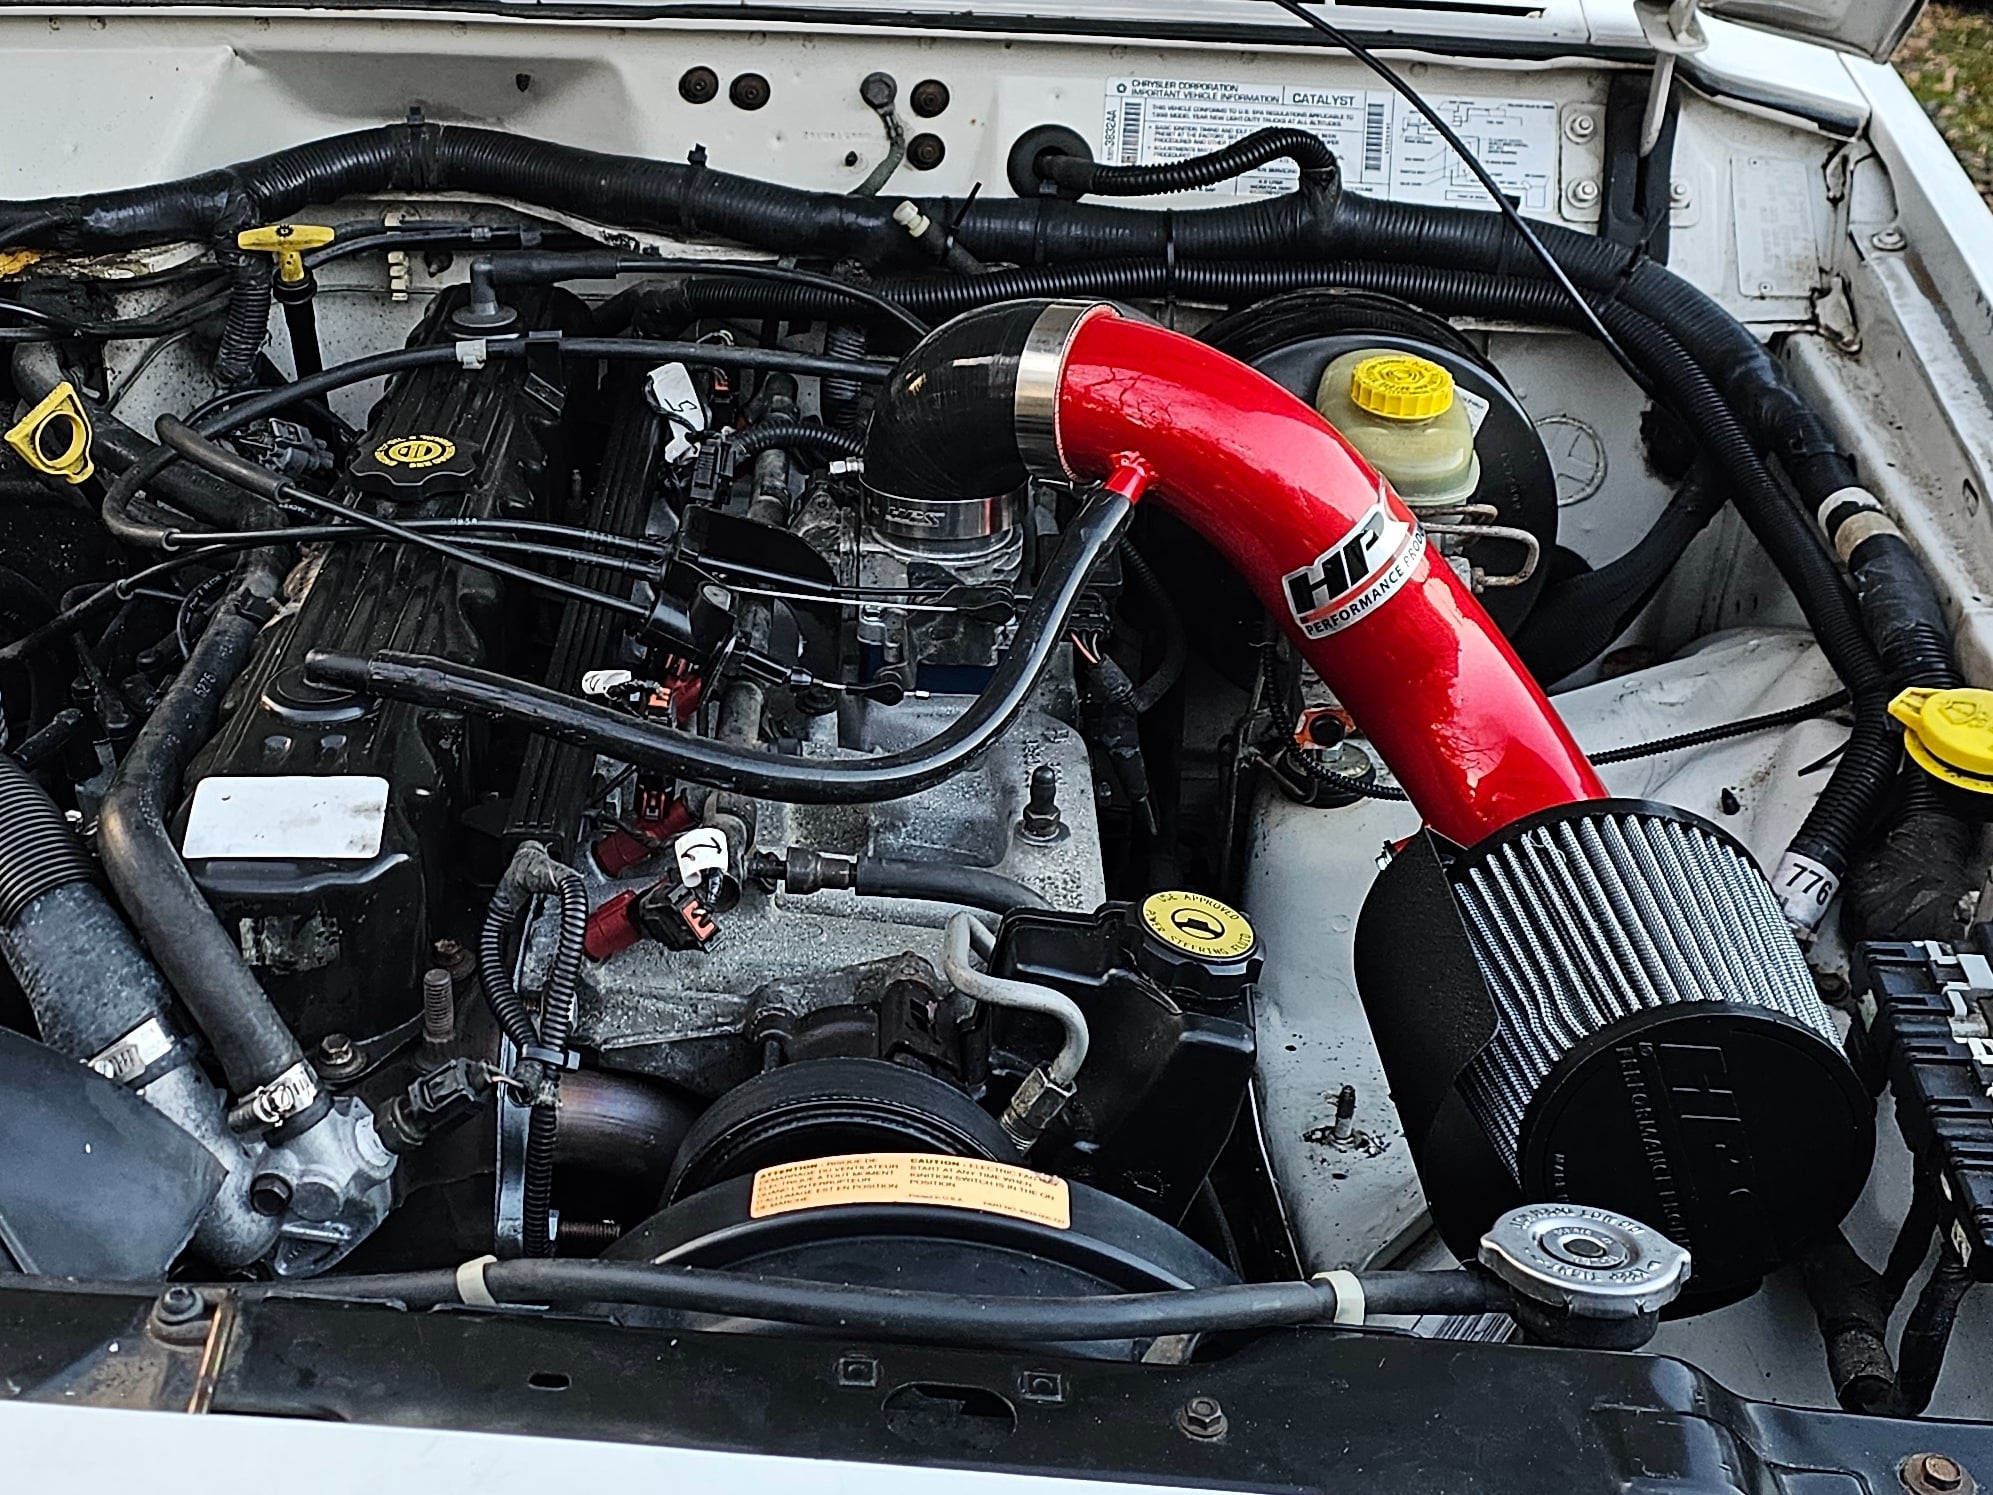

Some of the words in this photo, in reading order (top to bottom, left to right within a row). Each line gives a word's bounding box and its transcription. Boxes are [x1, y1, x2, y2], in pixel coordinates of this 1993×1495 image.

[1131, 79, 1177, 90] CHRYSLER
[1178, 81, 1239, 93] CORPORATION
[1131, 88, 1181, 98] IMPORTANT
[1183, 91, 1218, 100] VEHICLE
[1220, 92, 1280, 103] INFORMATION
[1292, 92, 1356, 107] CATALYST
[1104, 109, 1117, 147] 3832AA
[1304, 566, 1405, 636] PERFORMANCE
[1785, 862, 1833, 906] 776
[1183, 893, 1240, 921] APPROVED
[760, 1163, 818, 1179] ATTENTION
[835, 1163, 899, 1172] VENTILATEUR
[910, 1157, 960, 1167] CAUTION
[969, 1162, 1016, 1176] ELECTRIC
[909, 1172, 953, 1181] IGNITION
[955, 1175, 993, 1187] SWITCH
[909, 1179, 956, 1188] POSITION
[955, 1168, 975, 1176] ANY
[978, 1171, 999, 1181] TIME
[1002, 1176, 1033, 1188] WHEN
